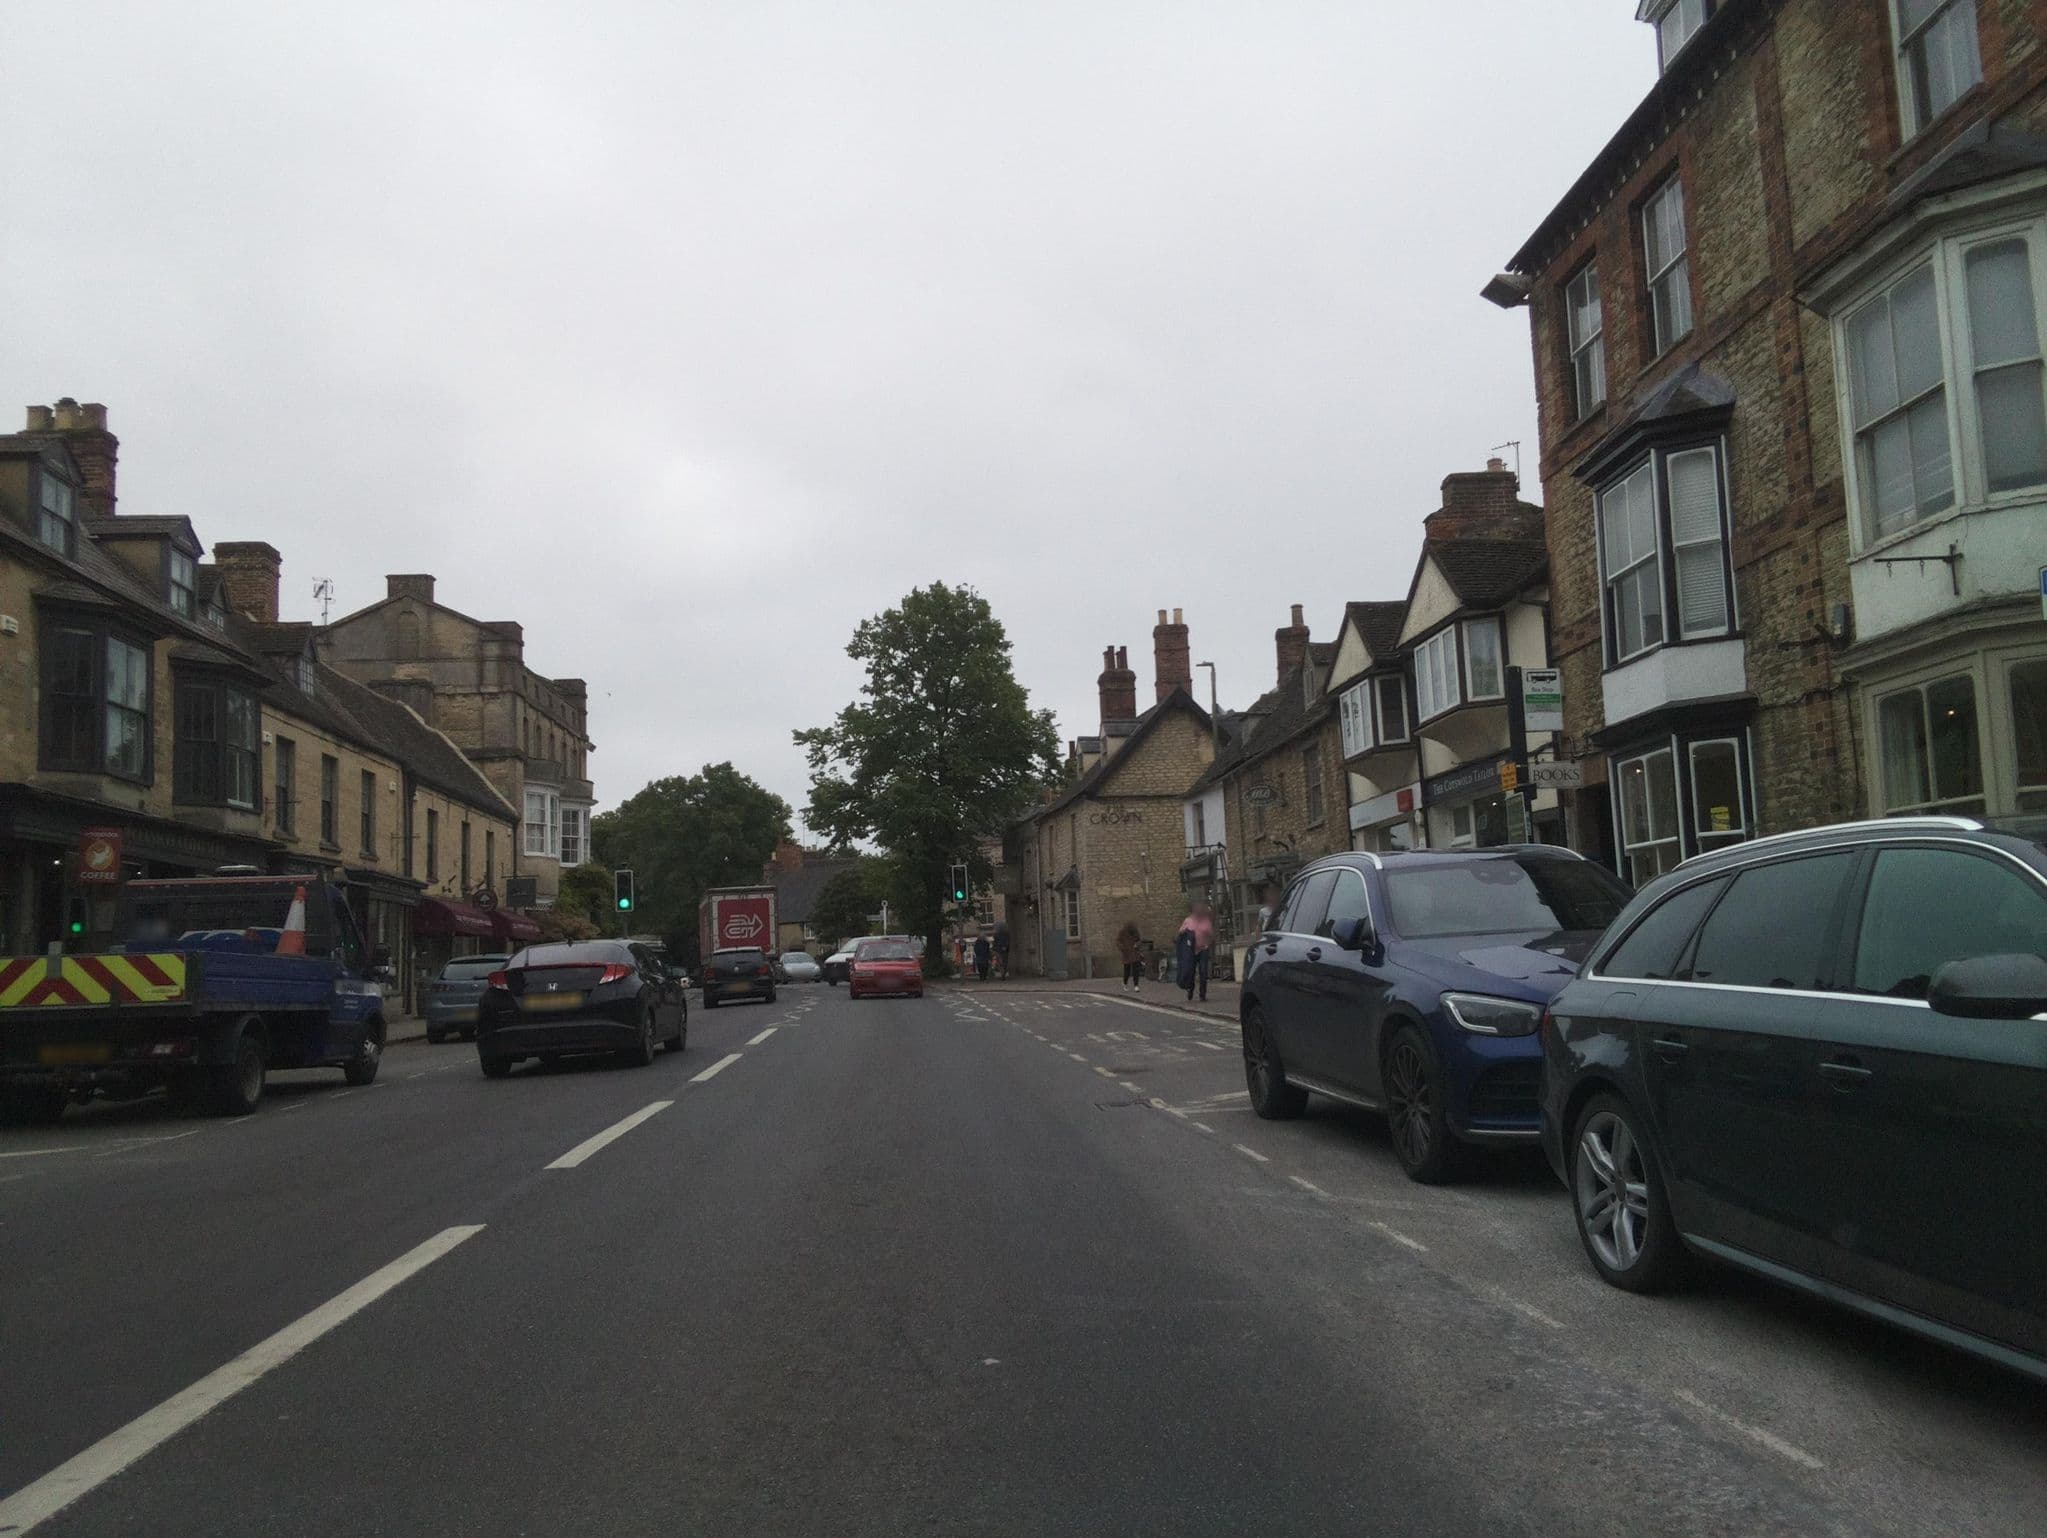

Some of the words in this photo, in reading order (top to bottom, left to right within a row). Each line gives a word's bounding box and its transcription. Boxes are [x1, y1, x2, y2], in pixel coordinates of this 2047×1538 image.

[1533, 767, 1580, 781] BOOKS
[1090, 812, 1143, 825] CROWN
[80, 871, 118, 880] COFFEE
